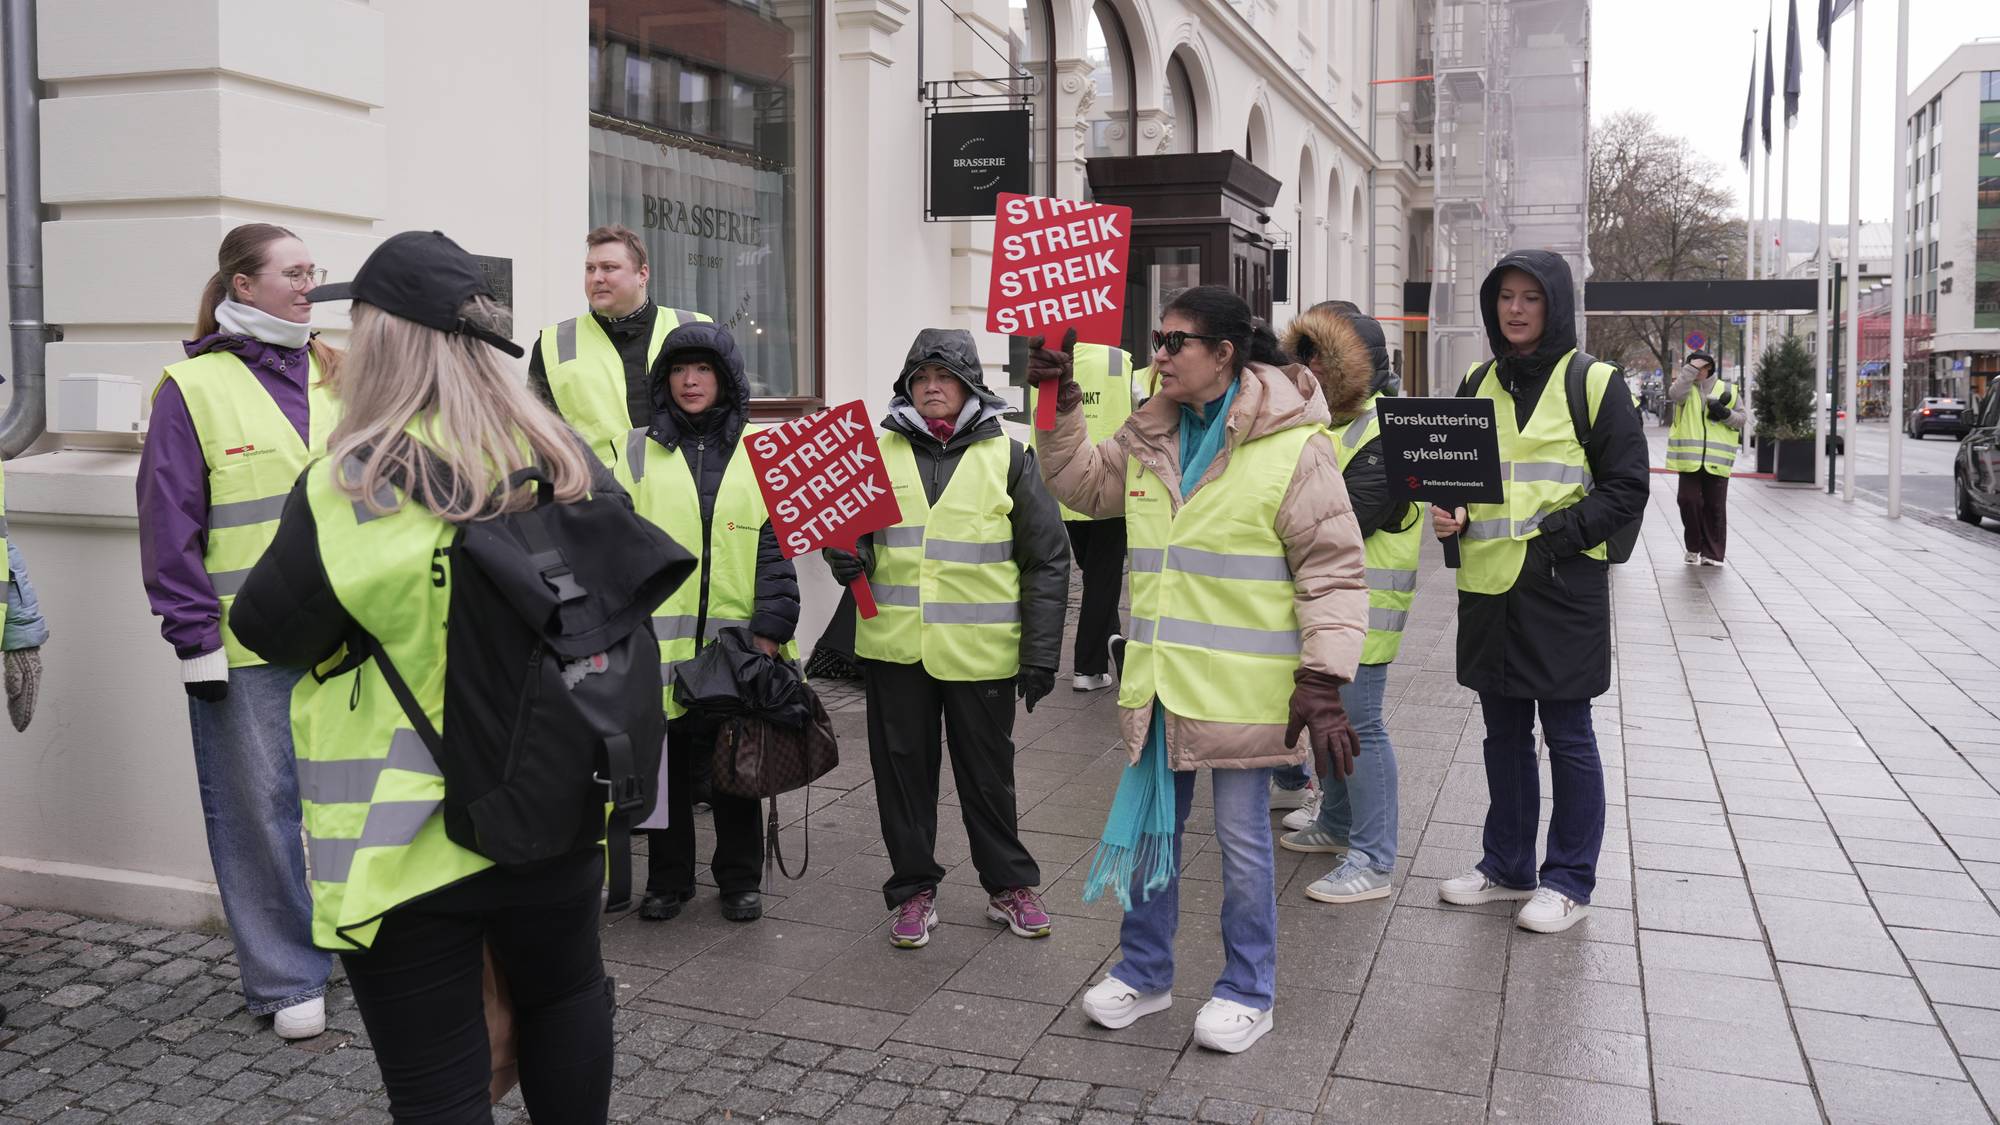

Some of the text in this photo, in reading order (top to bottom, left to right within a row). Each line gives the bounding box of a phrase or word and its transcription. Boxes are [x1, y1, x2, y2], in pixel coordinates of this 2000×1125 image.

[953, 157, 1006, 168] BRASSERIE
[642, 193, 761, 247] BRASSERIE
[1002, 213, 1123, 261] STREIK
[688, 253, 723, 269] EST. 1897
[999, 249, 1120, 297] STREIK
[996, 285, 1117, 334] STREIK
[1384, 413, 1489, 429] Forskuttering
[1429, 433, 1448, 443] av
[765, 409, 865, 492] STREIK
[1403, 448, 1479, 462] sykelønn!
[776, 441, 876, 523] STREIK
[1423, 479, 1484, 487] Fellesforbundet
[787, 473, 887, 554] STREIK
